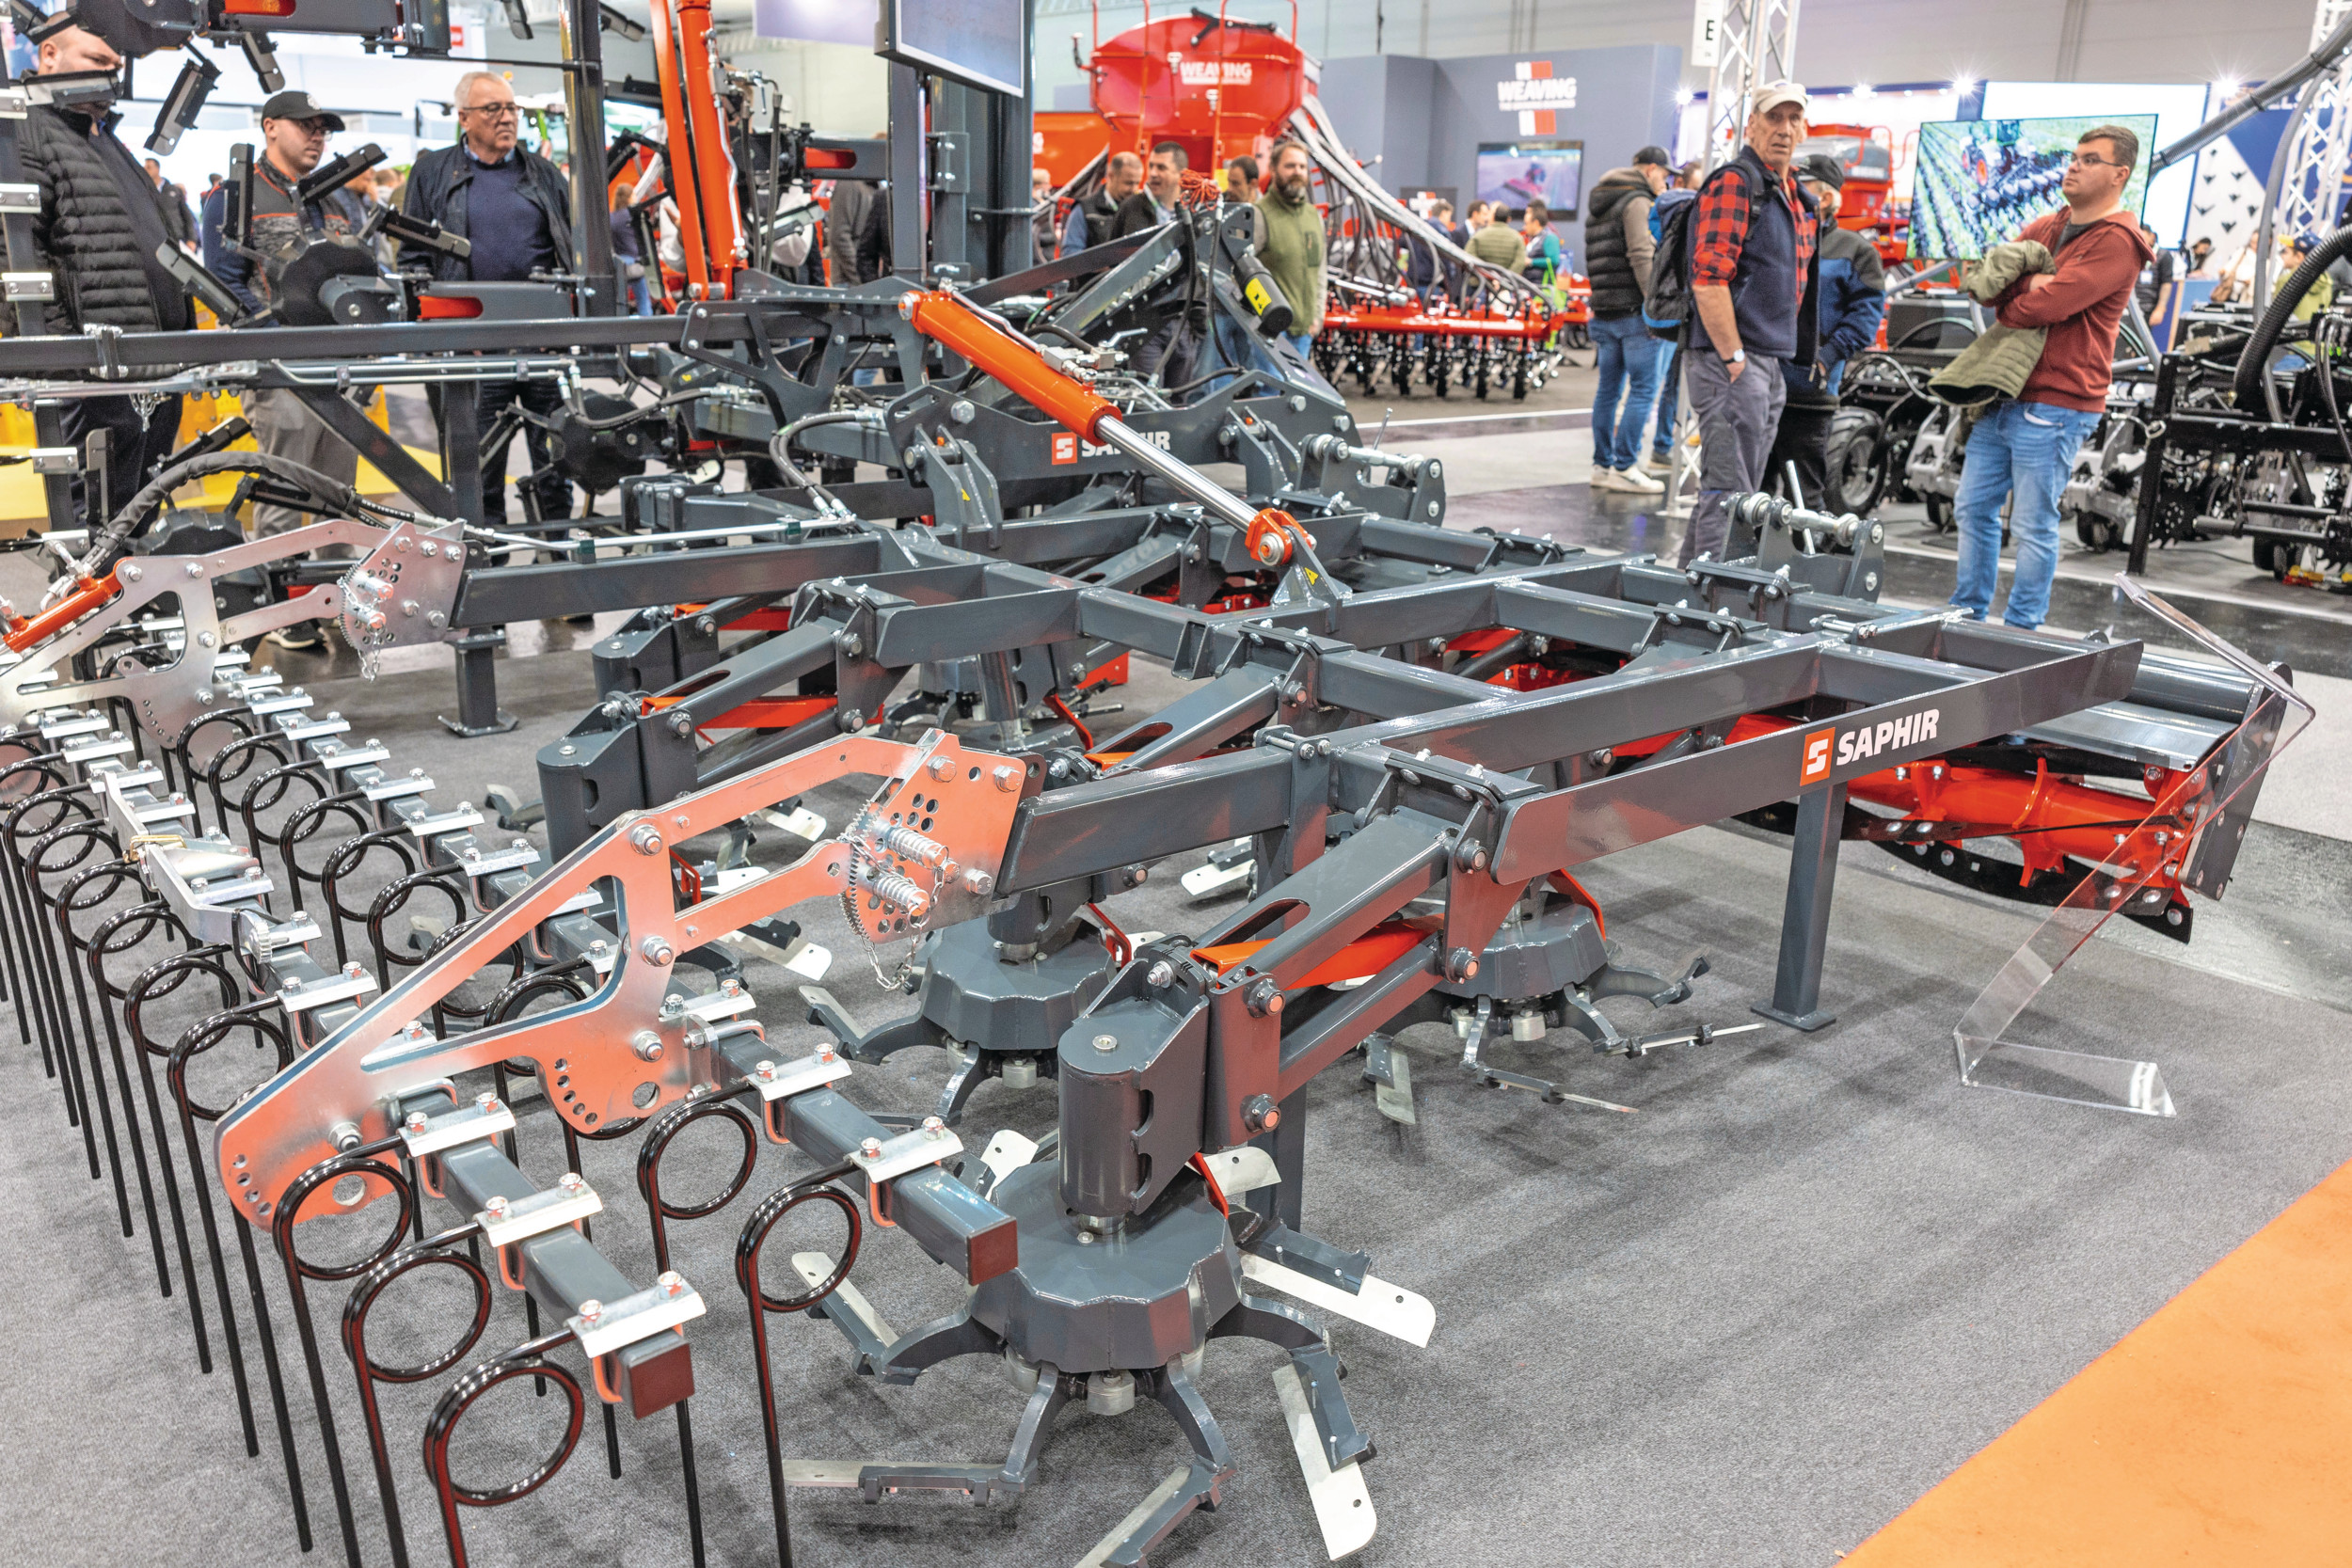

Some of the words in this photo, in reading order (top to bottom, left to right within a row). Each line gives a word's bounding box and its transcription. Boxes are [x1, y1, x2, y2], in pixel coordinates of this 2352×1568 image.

[1706, 20, 1715, 40] E
[1180, 61, 1252, 77] WEAVING
[1498, 77, 1577, 102] WEAVING
[1836, 708, 1940, 766] SAPHIR
